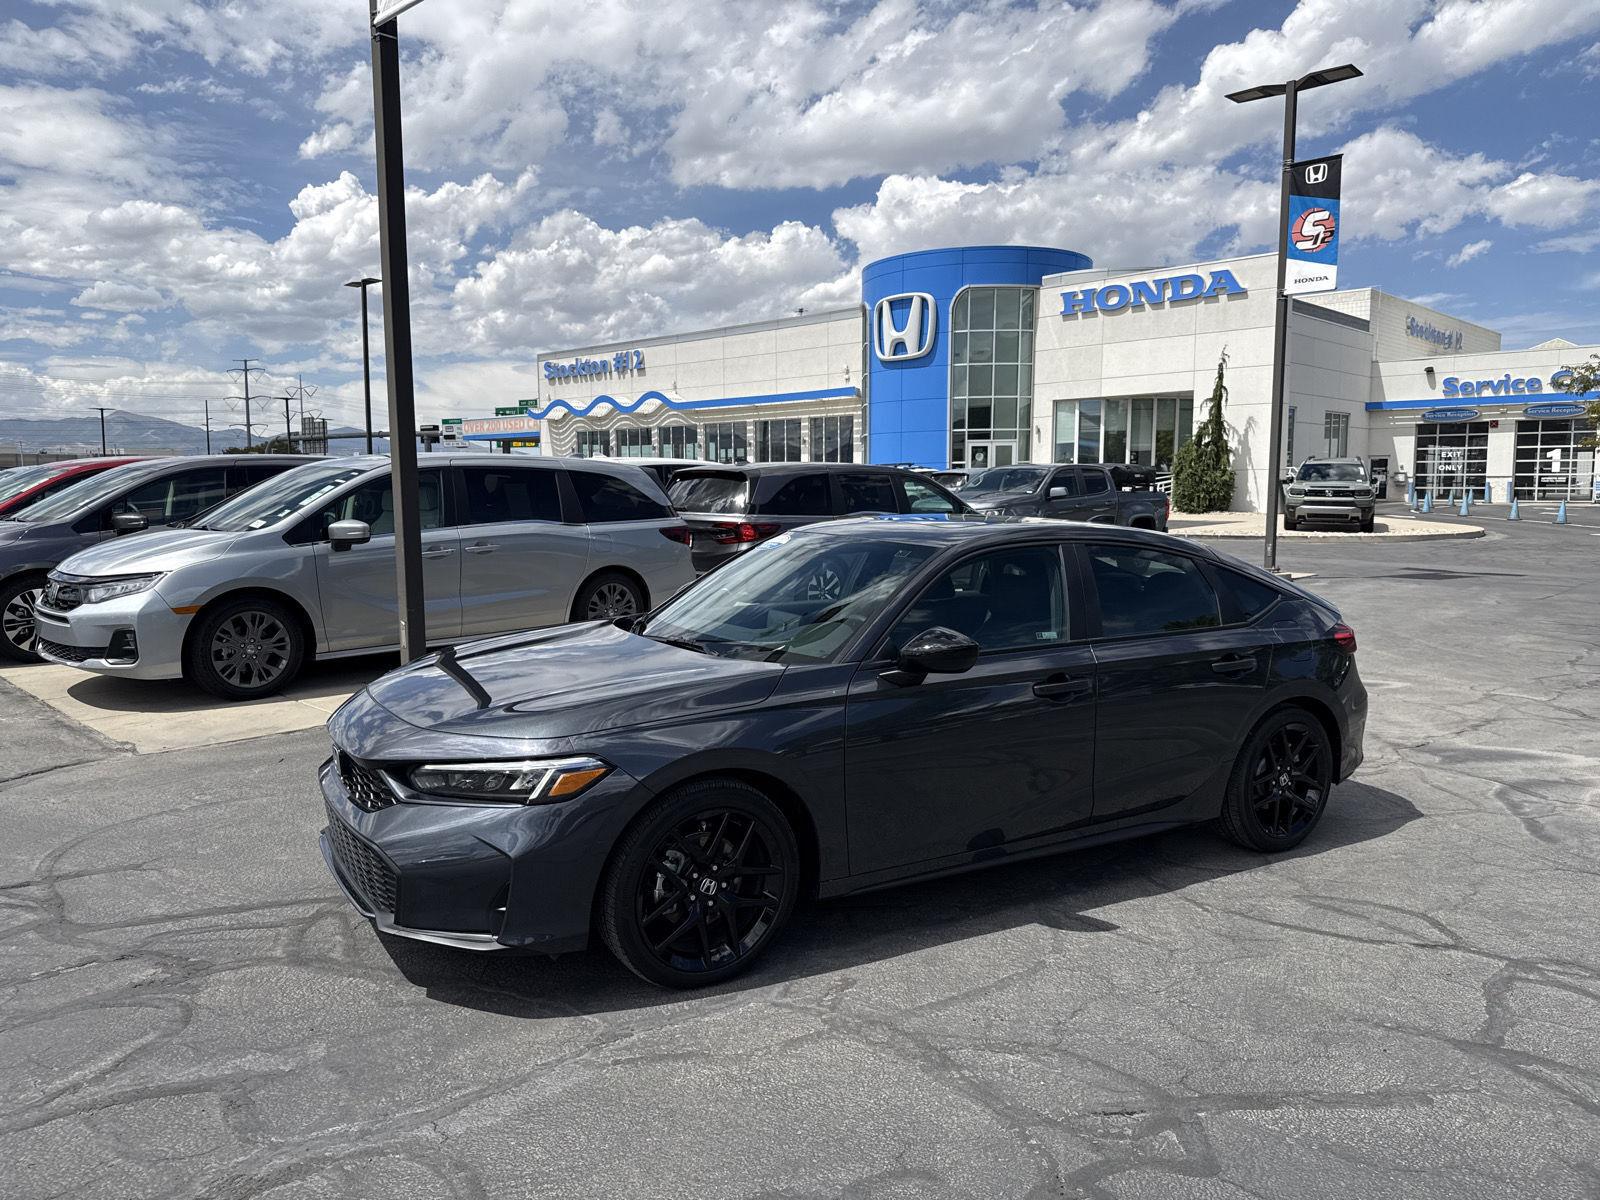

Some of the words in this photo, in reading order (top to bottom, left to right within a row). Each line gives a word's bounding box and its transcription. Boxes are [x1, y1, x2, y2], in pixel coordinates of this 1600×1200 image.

[1294, 275, 1329, 285] HONDA
[1060, 269, 1247, 316] HONDA
[544, 358, 609, 379] Stockton
[613, 350, 644, 373] #12
[1443, 374, 1543, 396] Service
[464, 421, 485, 433] OVER
[486, 420, 501, 432] 200
[502, 418, 525, 431] USED
[1446, 411, 1476, 419] Reception
[1546, 449, 1562, 473] 1
